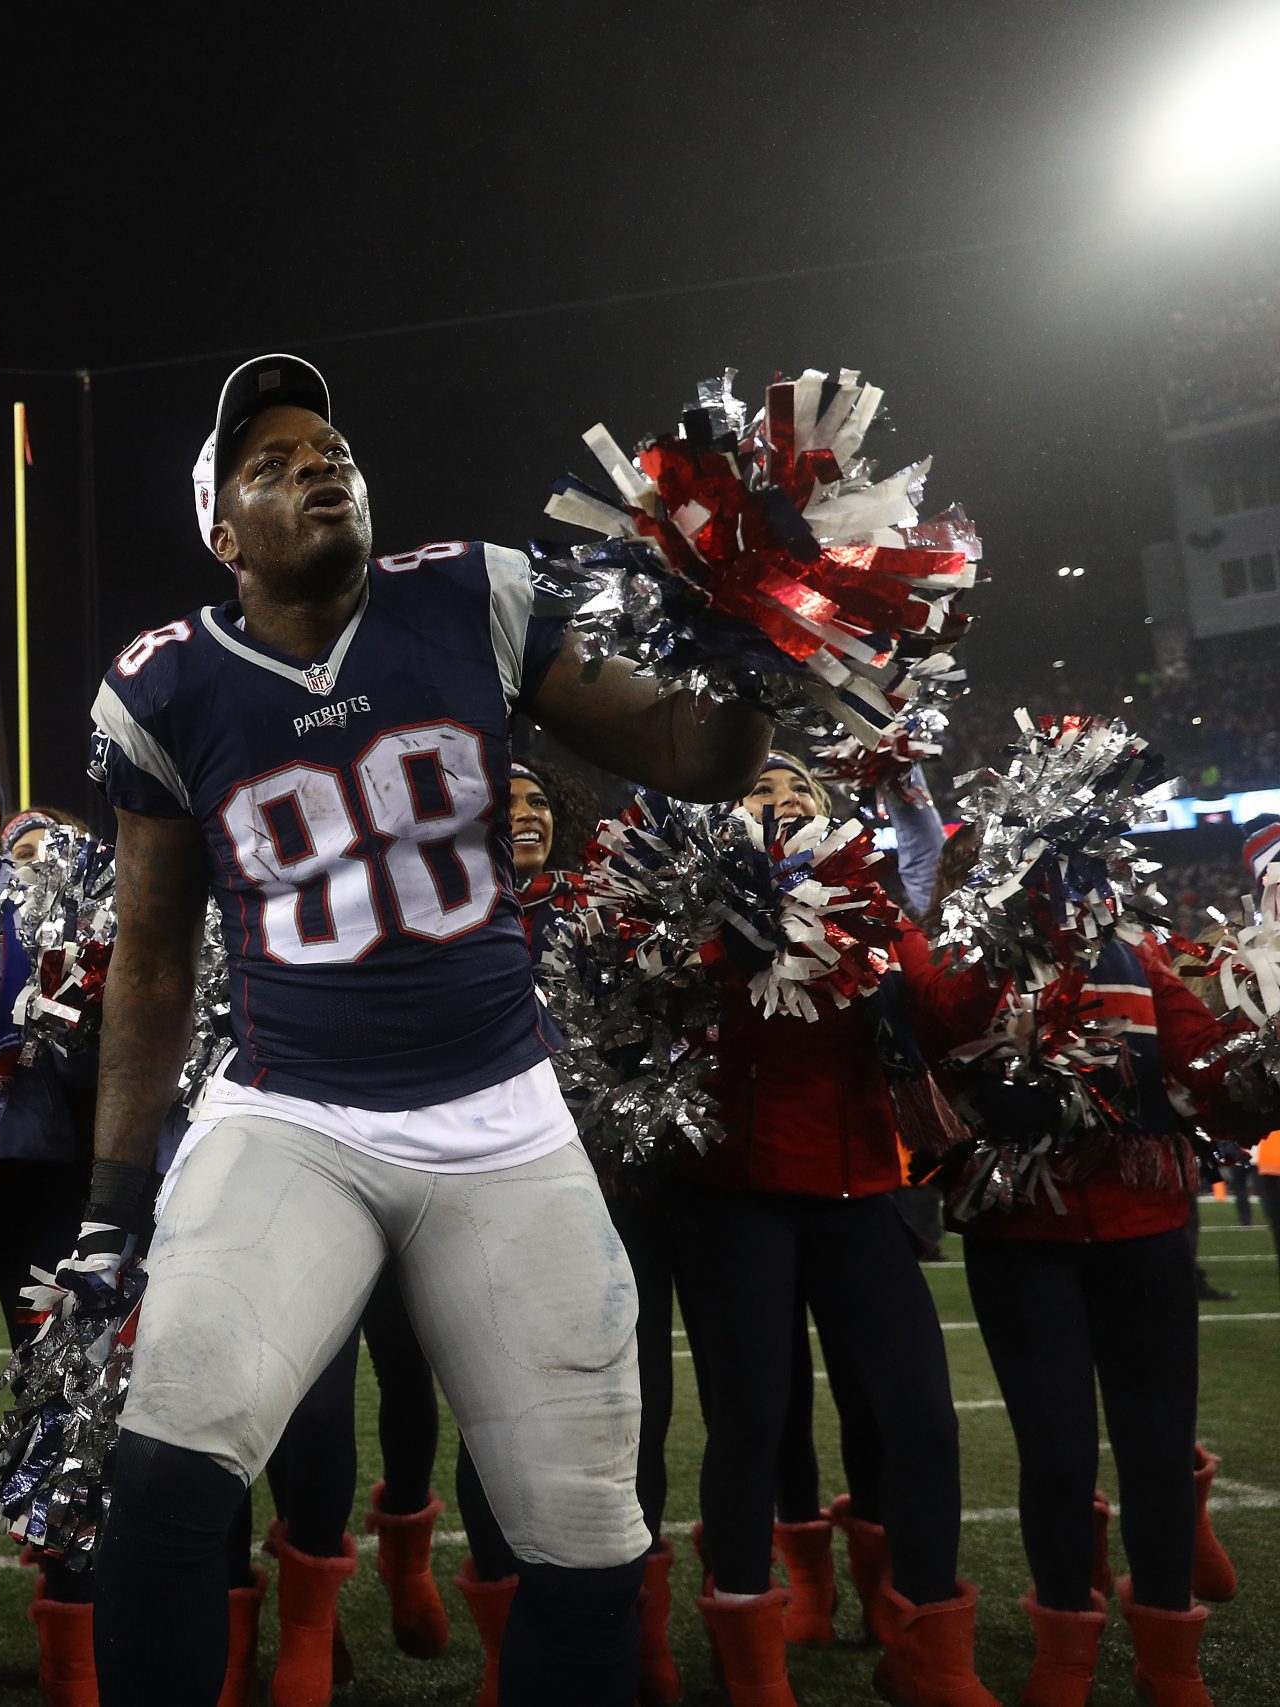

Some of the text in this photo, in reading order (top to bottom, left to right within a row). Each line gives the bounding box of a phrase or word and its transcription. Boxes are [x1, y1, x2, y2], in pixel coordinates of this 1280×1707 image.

[309, 674, 332, 690] NFL
[292, 695, 371, 737] PATRIOTS
[220, 718, 502, 965] 88
